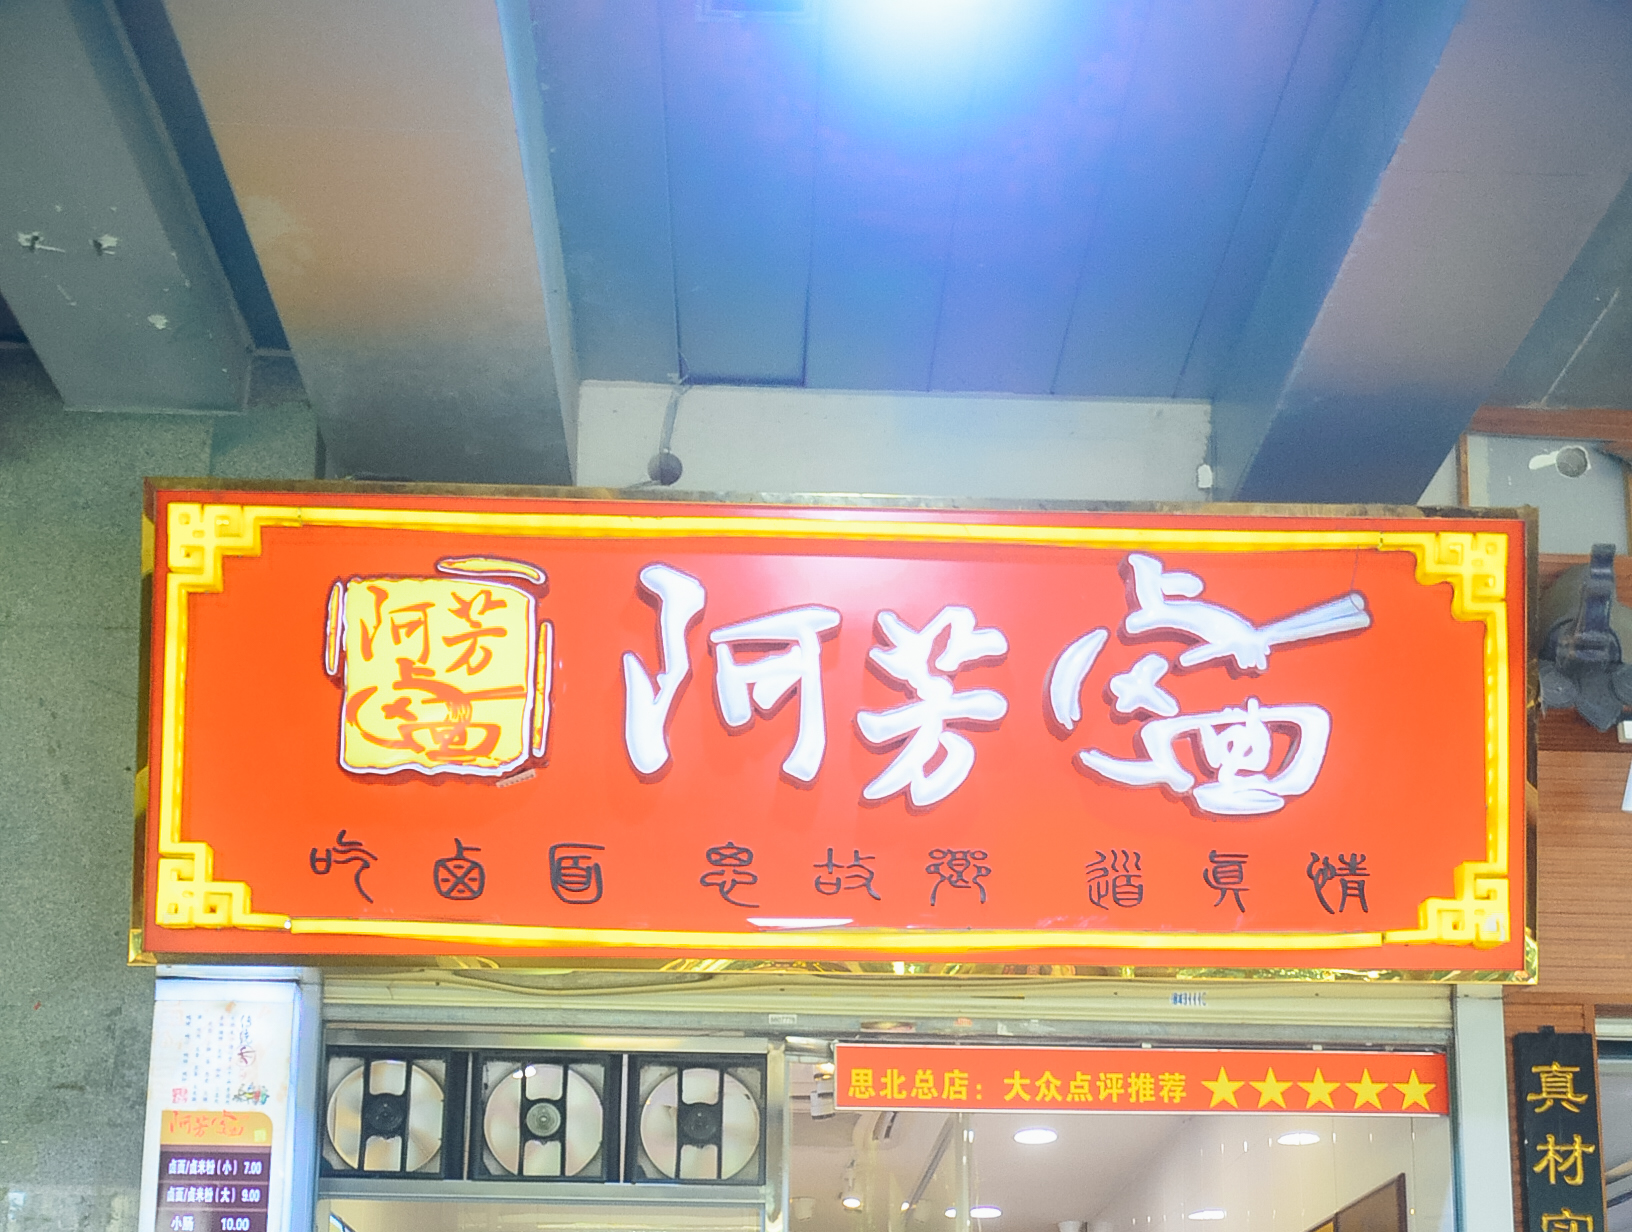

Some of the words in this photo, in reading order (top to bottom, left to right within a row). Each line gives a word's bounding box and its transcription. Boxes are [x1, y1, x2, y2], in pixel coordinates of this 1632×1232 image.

[360, 586, 507, 675] 阿芳
[847, 1066, 1188, 1103] 思北总店：大众点评推荐
[244, 1161, 263, 1175] 7.00
[241, 1188, 261, 1202] 9.00
[221, 1217, 250, 1231] 10.00
